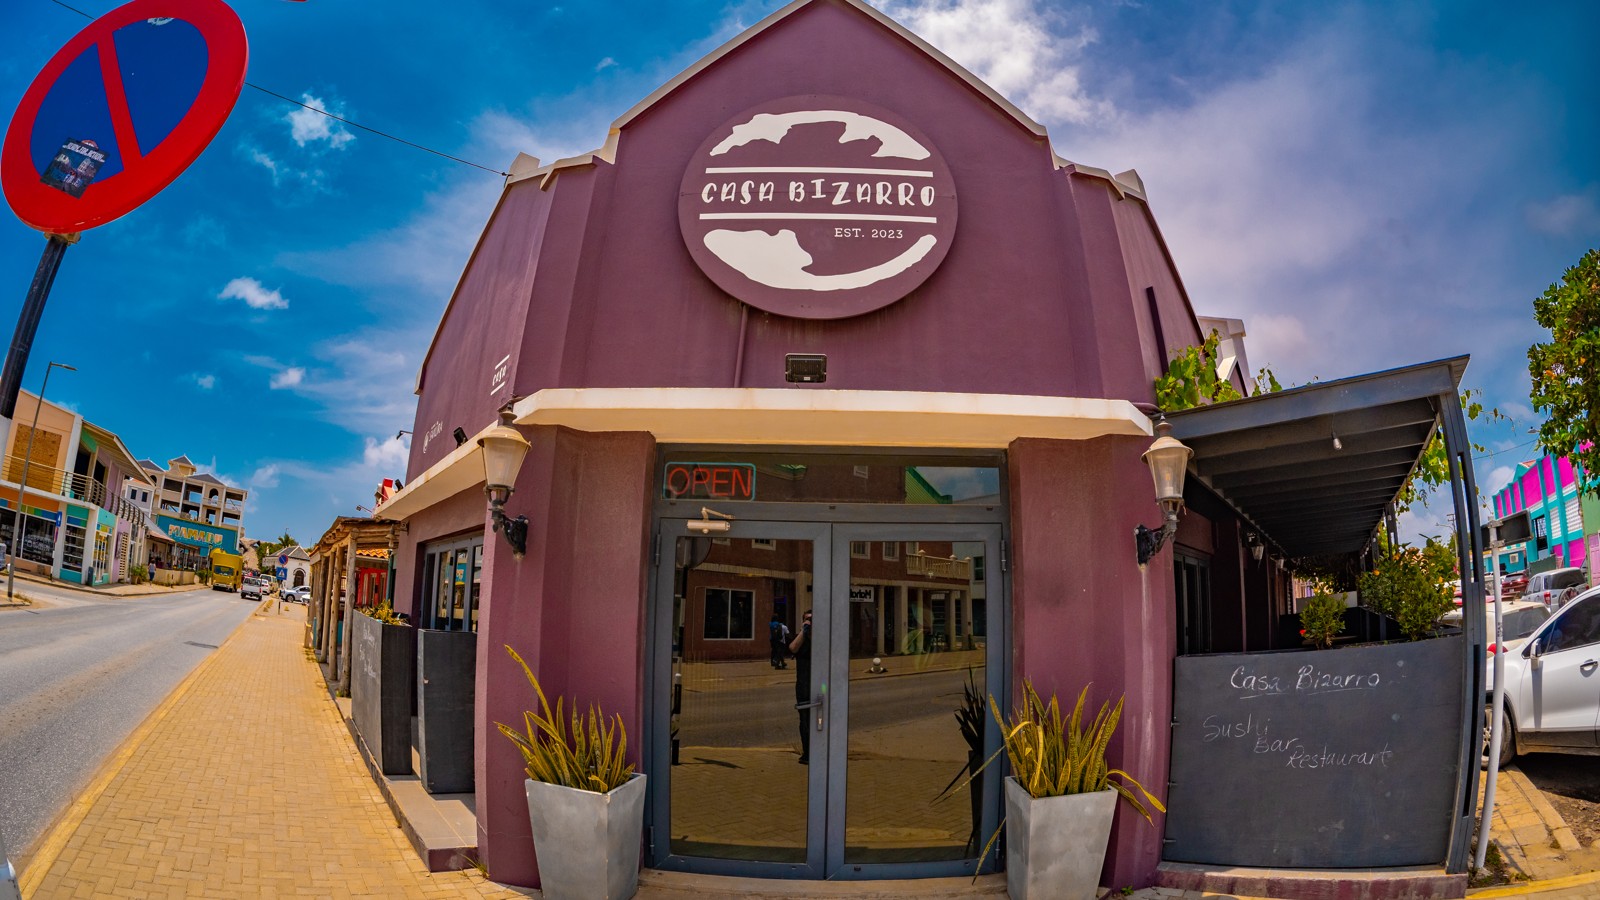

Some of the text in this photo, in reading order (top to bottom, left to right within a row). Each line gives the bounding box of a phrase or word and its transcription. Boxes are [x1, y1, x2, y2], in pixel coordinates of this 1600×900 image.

[701, 178, 935, 207] CASA BIZARRO
[834, 227, 903, 240] EST. 2023
[667, 467, 752, 497] OPEN
[1230, 664, 1380, 693] Casa Bizarro
[1202, 713, 1271, 742] Sushi
[1253, 736, 1300, 754] Bar
